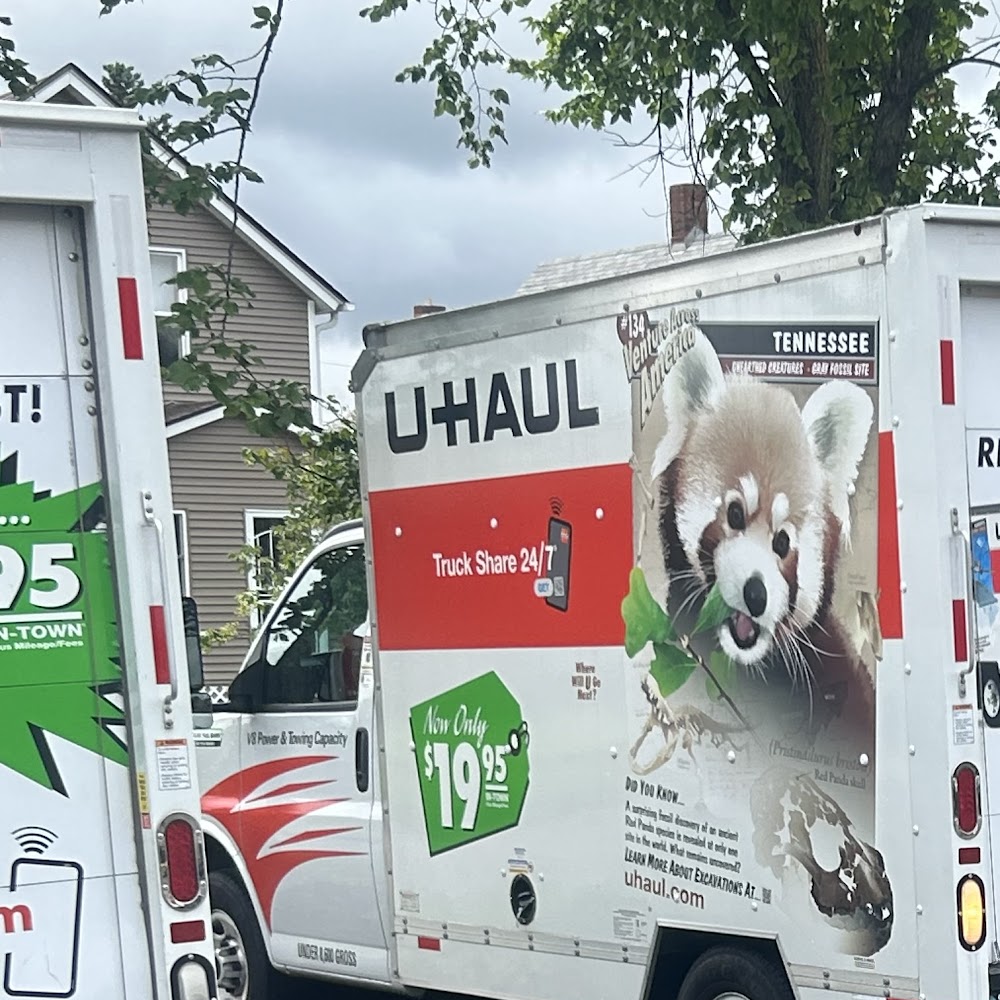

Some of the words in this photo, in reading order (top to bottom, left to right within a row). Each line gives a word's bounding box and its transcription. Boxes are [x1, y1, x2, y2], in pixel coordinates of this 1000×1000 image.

[772, 331, 870, 354] TENNESSEE
[385, 359, 600, 454] U-HAUL
[432, 551, 473, 577] Truck
[475, 548, 518, 575] Share
[520, 540, 554, 577] 24/7
[314, 730, 348, 748] Capacity
[423, 705, 450, 734] Now
[453, 704, 489, 748] Only
[624, 846, 647, 867] LEARN
[647, 852, 669, 873] MORE
[669, 860, 695, 882] ABOUT
[694, 867, 744, 897] EXCAVATIONS
[624, 869, 705, 910] uhaul.com
